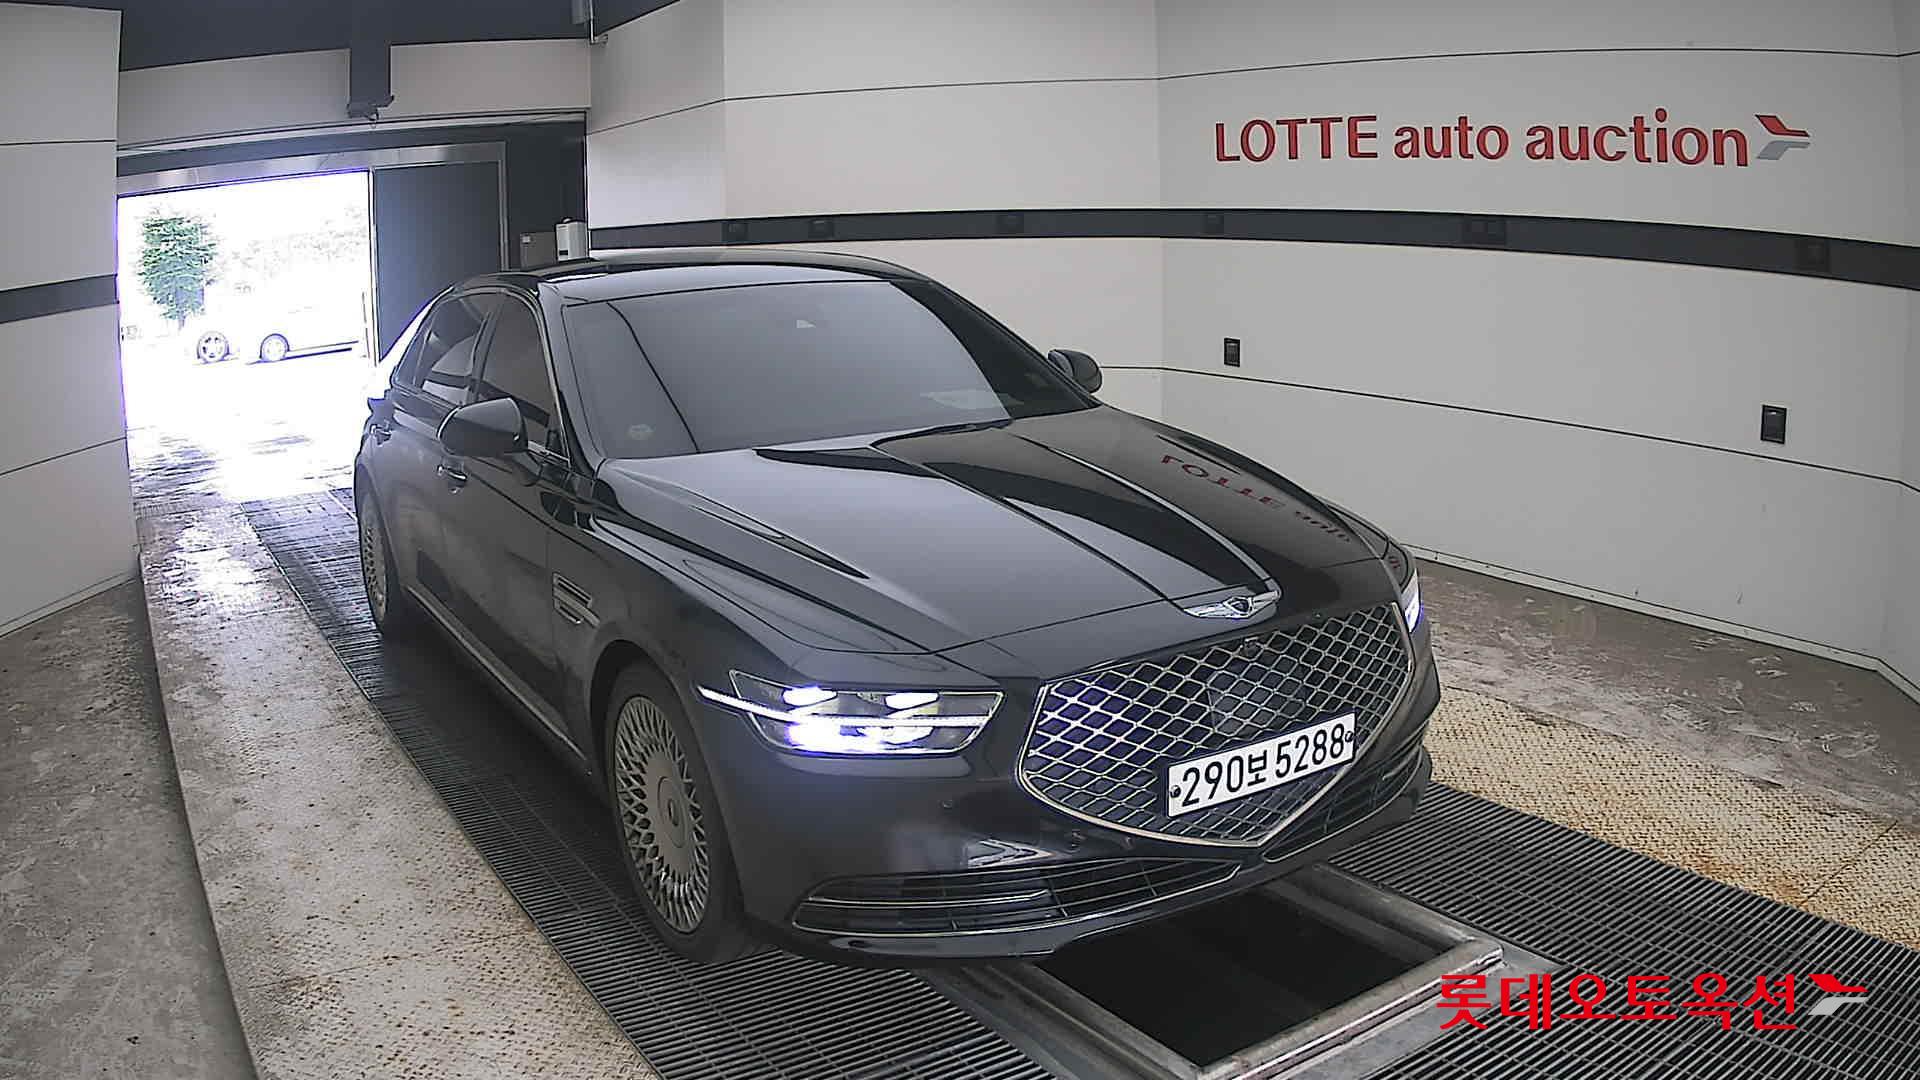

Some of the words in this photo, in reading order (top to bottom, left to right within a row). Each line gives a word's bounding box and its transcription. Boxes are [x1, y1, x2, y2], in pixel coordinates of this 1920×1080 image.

[1214, 115, 1378, 162] LOTTE
[1393, 115, 1510, 161] auto
[1525, 107, 1749, 167] auction
